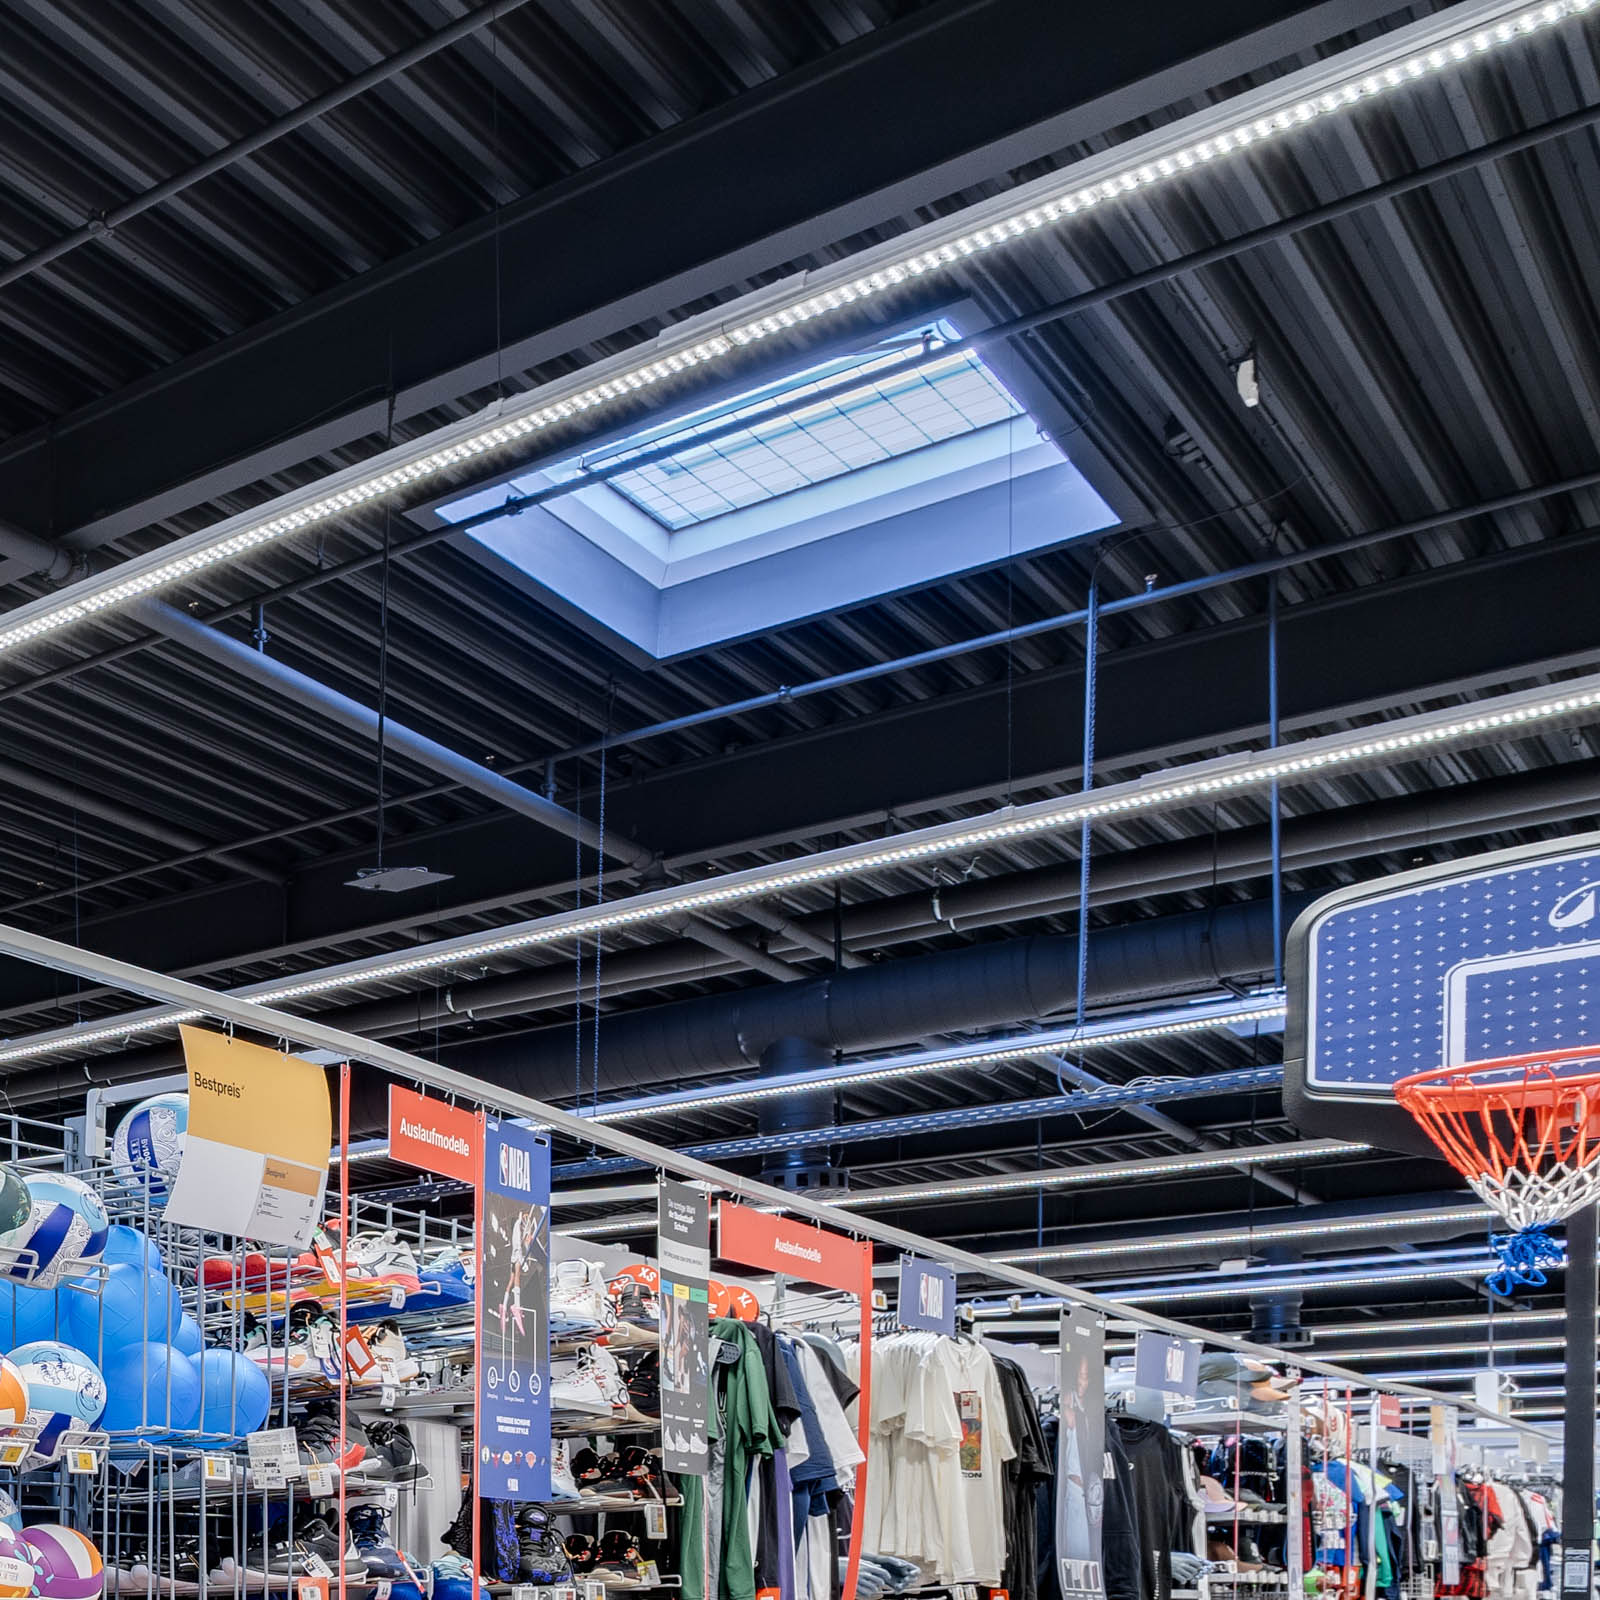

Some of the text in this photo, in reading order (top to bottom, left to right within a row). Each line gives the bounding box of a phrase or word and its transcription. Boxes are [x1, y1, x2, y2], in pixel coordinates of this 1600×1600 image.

[194, 1072, 241, 1098] Bestpreis
[399, 1117, 470, 1156] Auslaufmodelle
[508, 1145, 532, 1193] NBA
[774, 1237, 822, 1264] Auslaufmodelle
[638, 1266, 657, 1283] XS
[737, 1291, 753, 1308] XL
[388, 1493, 396, 1502] 45
[381, 1587, 389, 1596] 44
